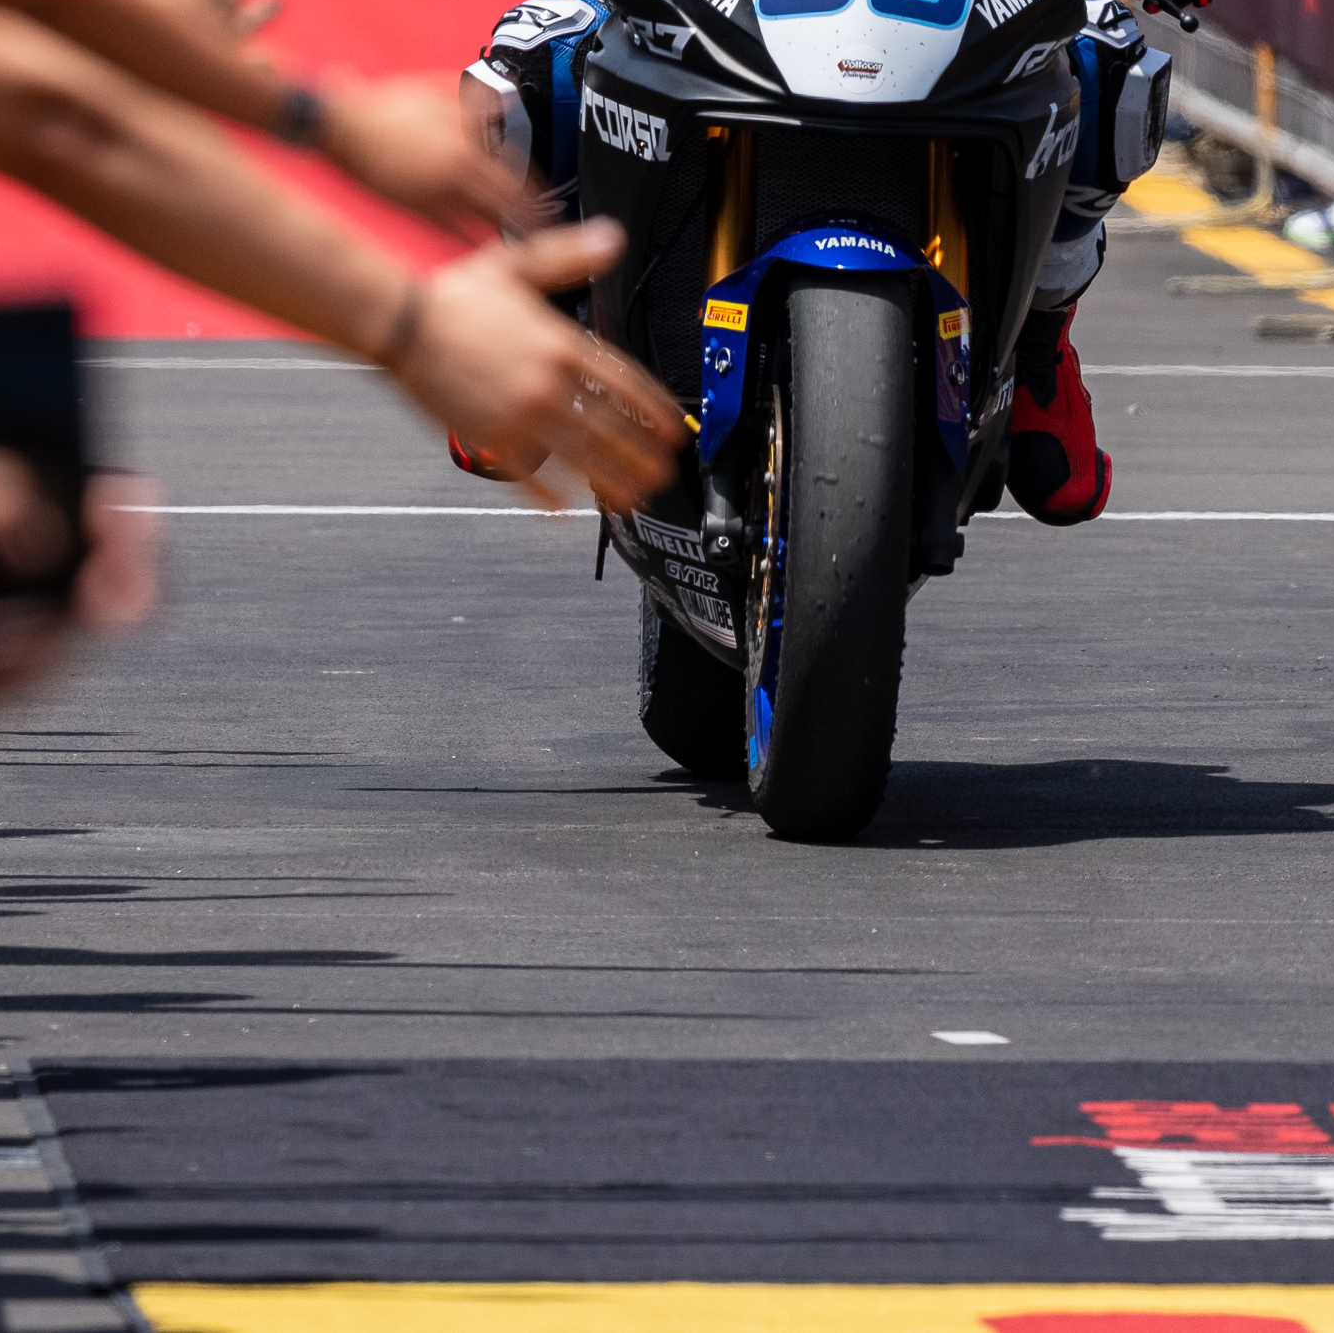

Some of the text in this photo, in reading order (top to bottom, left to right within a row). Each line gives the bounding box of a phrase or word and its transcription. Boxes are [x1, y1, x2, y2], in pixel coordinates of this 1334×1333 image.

[815, 236, 896, 258] YAMAHA
[705, 305, 744, 325] PIRELLI
[631, 507, 706, 563] PIRELLI
[665, 559, 719, 593] GYTR
